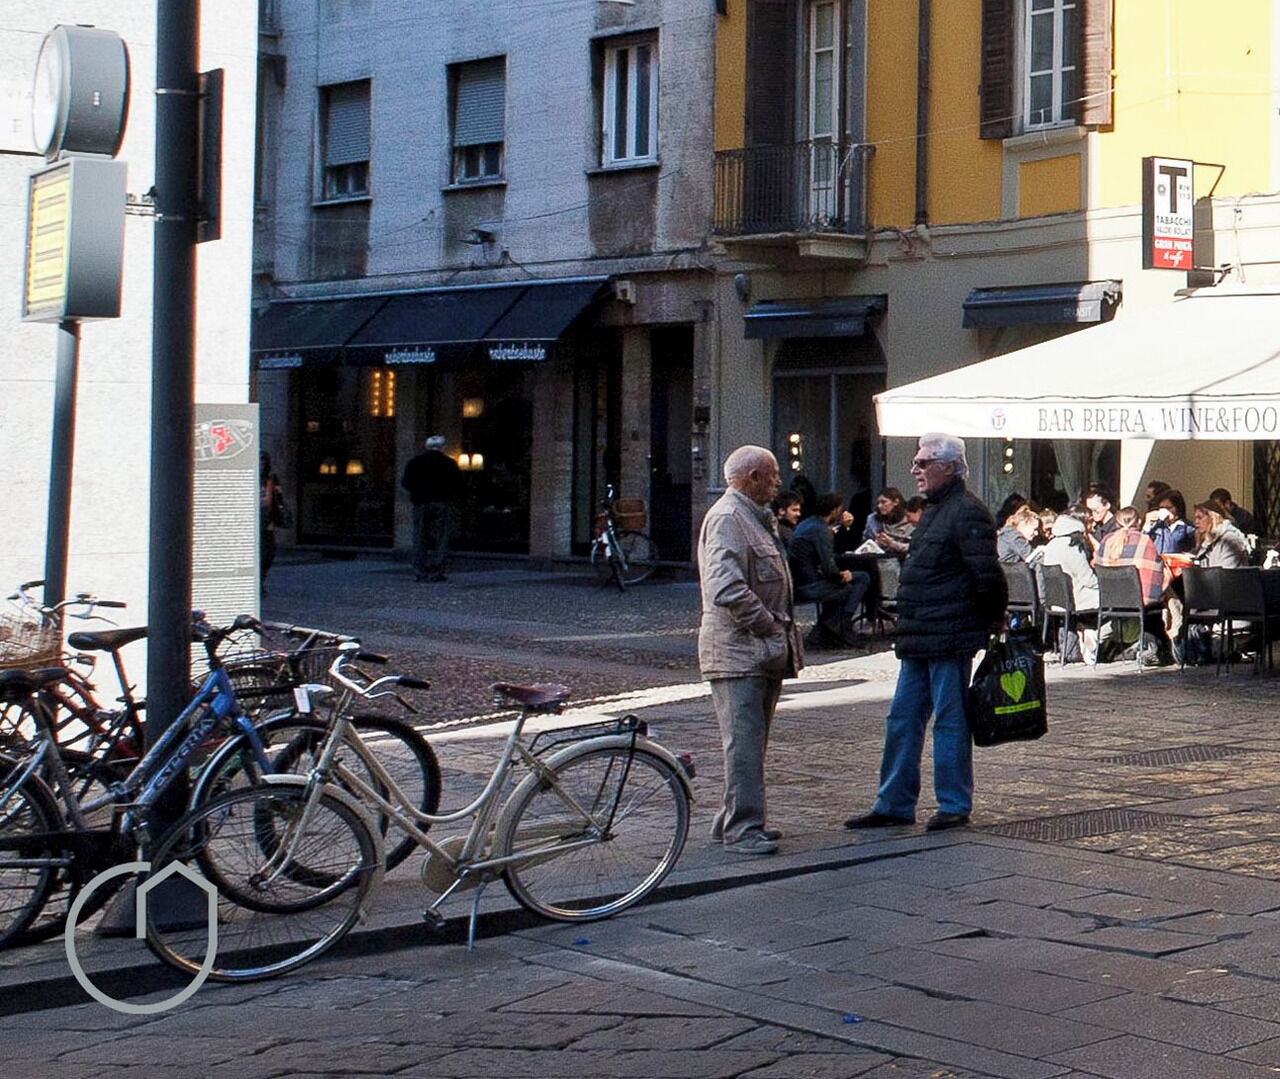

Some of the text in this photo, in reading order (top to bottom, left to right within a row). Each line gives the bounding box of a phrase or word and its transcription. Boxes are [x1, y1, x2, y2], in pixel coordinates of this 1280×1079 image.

[1159, 165, 1187, 214] T
[1156, 215, 1191, 226] TABACCHI
[1038, 407, 1074, 432] BAR
[1083, 407, 1147, 433] BRERA
